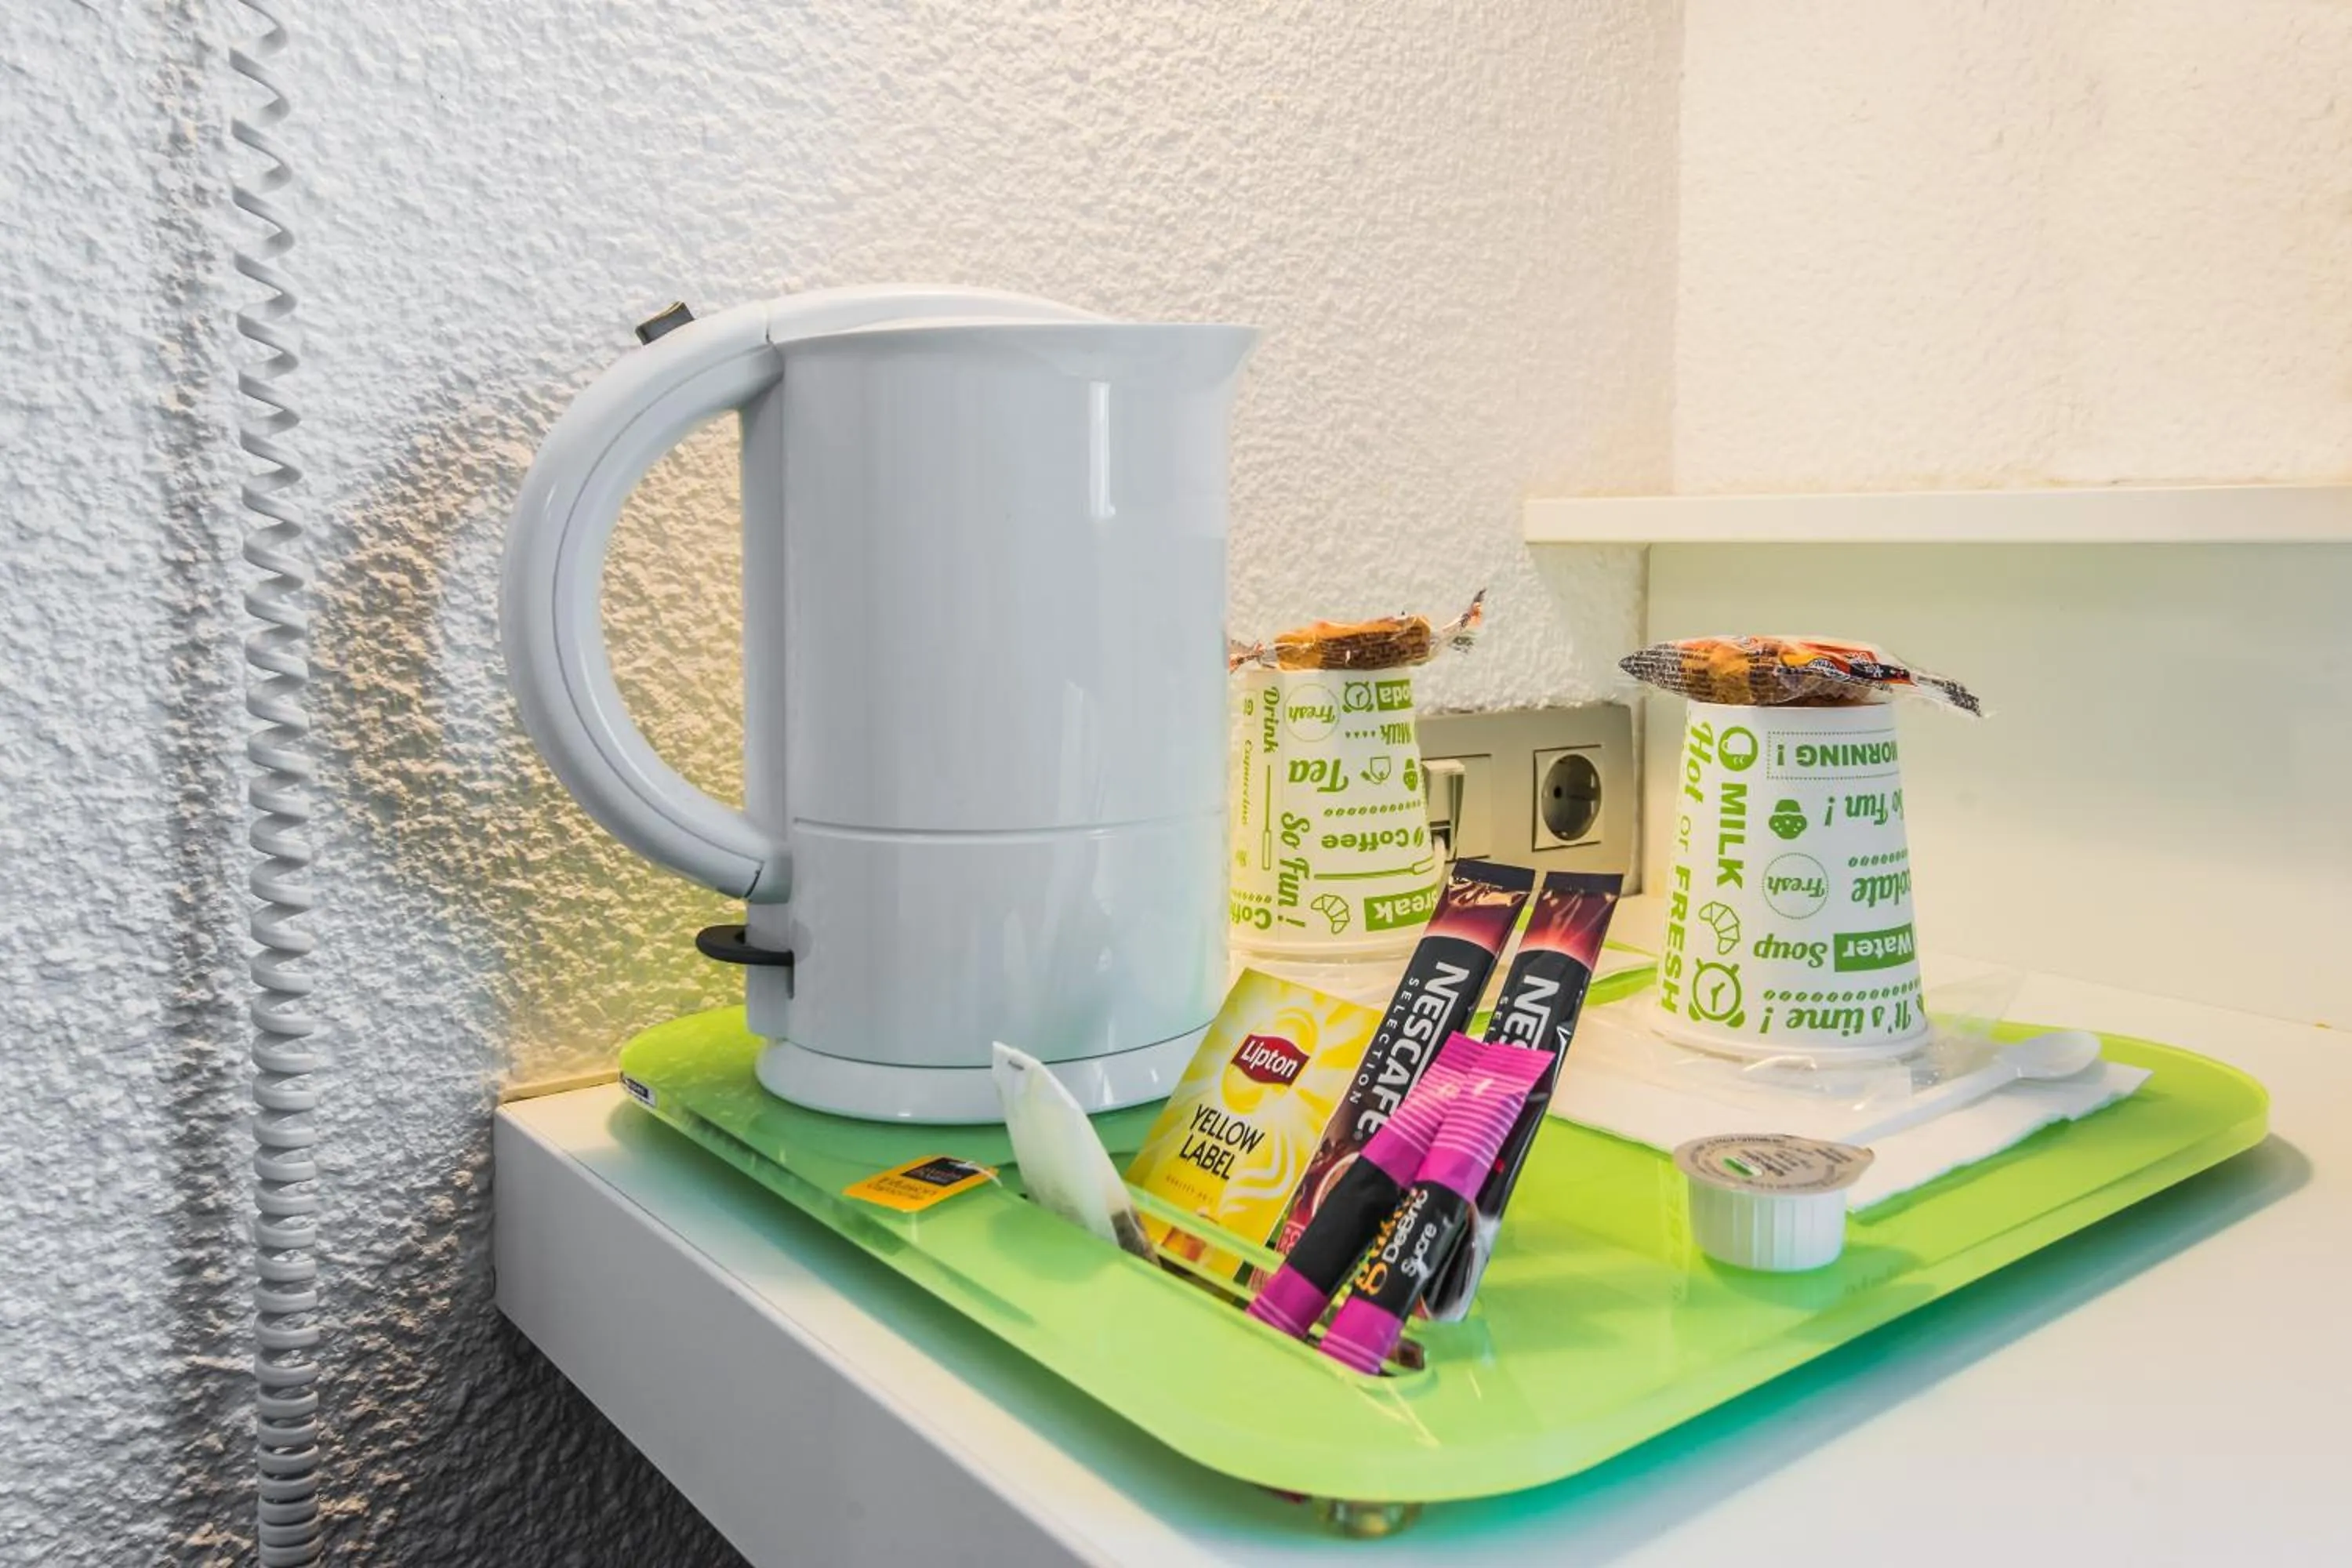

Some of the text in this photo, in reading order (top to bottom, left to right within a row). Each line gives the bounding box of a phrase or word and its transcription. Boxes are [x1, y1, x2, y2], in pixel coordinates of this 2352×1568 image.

[1378, 683, 1411, 705] oda
[1263, 686, 1281, 755] Drink
[1288, 704, 1336, 724] Fresh
[1378, 721, 1412, 746] Milk
[1776, 743, 1785, 766] !
[1288, 757, 1349, 793] Tea
[1846, 795, 1889, 826] Fun
[1279, 811, 1310, 848] So
[1321, 828, 1410, 853] Coffee
[1715, 782, 1747, 890] MILK
[1276, 857, 1311, 907] Fun
[1660, 720, 1714, 1014] Hot or FRESH
[1767, 876, 1826, 898] Fresh
[1753, 934, 1828, 969] Soup
[1843, 932, 1913, 960] Water
[1784, 1007, 1865, 1036] time
[1871, 1000, 1912, 1034] It's
[1348, 976, 1421, 1105] SELECTION
[1240, 1040, 1299, 1079] Lipton
[1189, 1103, 1266, 1155] YELLOW
[1178, 1134, 1239, 1181] LABEL
[1400, 1222, 1437, 1277] Sucre
